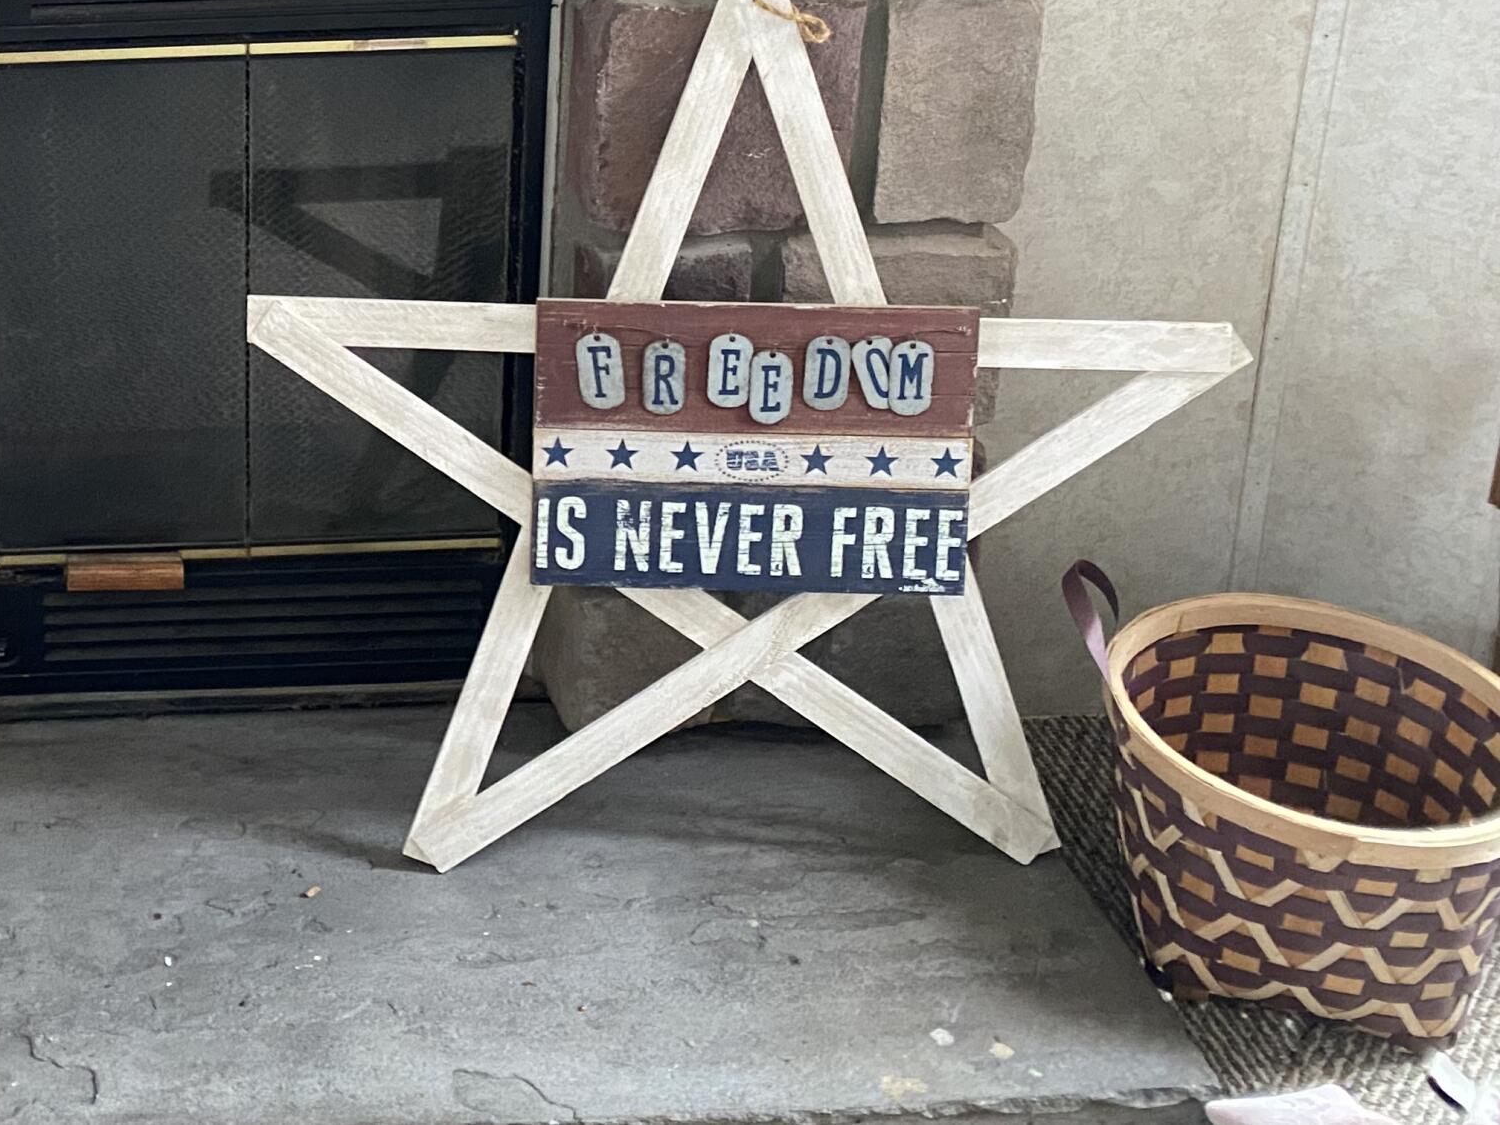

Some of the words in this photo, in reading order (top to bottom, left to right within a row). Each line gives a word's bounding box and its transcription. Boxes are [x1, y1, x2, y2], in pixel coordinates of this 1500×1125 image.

[587, 345, 930, 413] FREEDOM
[726, 450, 780, 472] USA
[535, 496, 588, 571] IS
[613, 499, 804, 578] NEVER
[830, 506, 964, 582] FREE
